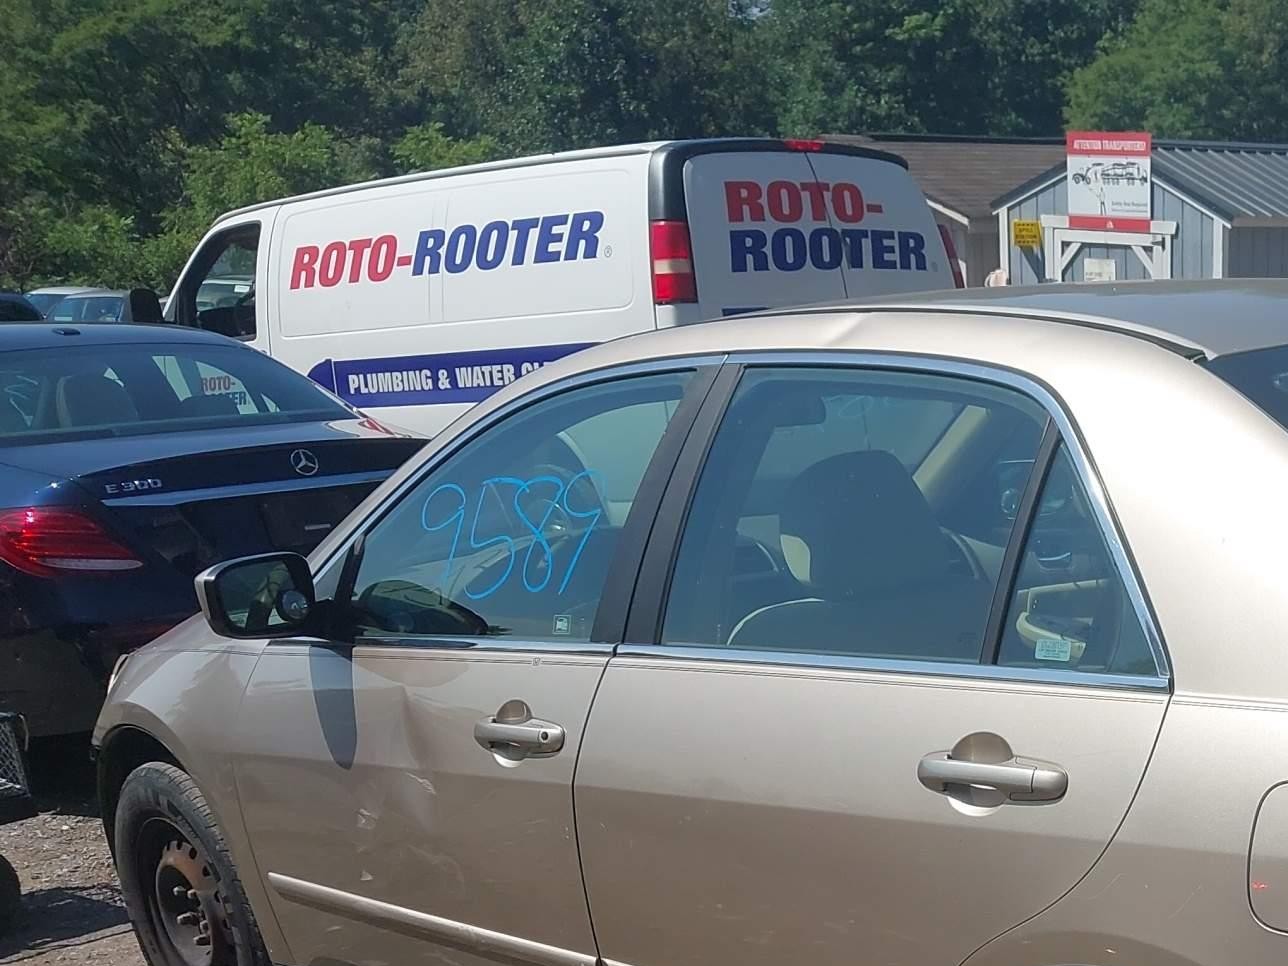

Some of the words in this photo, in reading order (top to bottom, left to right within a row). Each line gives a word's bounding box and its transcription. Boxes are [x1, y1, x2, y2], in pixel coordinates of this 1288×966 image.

[724, 180, 884, 224] ROTO-
[290, 211, 604, 290] ROTO-ROOTER
[730, 228, 928, 273] ROOTER
[348, 369, 433, 394] PLUMBING
[438, 369, 451, 390] &
[455, 365, 516, 388] WATER
[106, 484, 119, 494] E
[121, 478, 162, 491] 300
[422, 469, 607, 600] 9589
